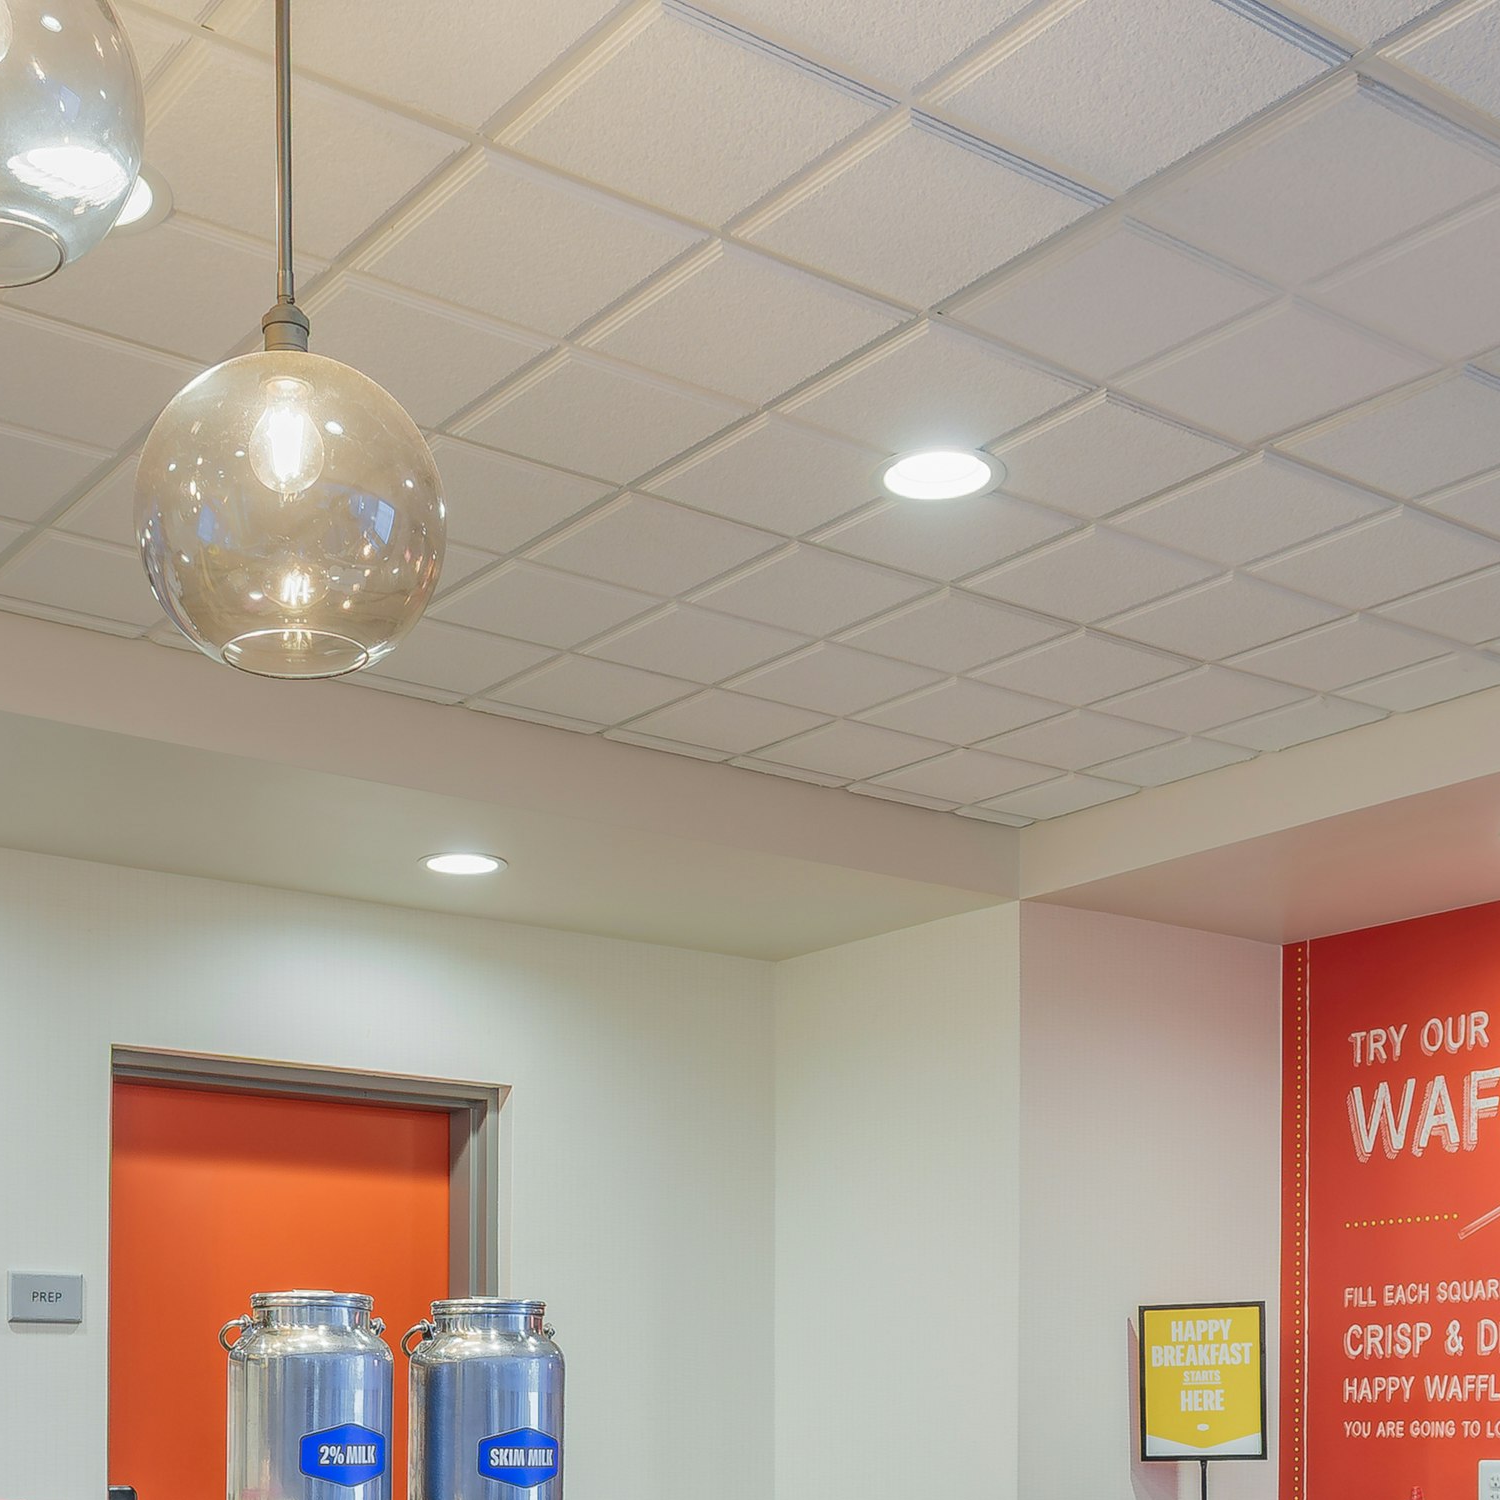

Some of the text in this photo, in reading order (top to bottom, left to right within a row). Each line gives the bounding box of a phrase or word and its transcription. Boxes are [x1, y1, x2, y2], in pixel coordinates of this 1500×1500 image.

[1349, 1024, 1407, 1067] TRY
[1420, 1011, 1490, 1056] OUR
[31, 1291, 62, 1303] PREP
[1344, 1286, 1377, 1308] FILL
[1383, 1283, 1430, 1306] EACH
[1171, 1318, 1233, 1342] HAPPY
[1343, 1322, 1432, 1360] CRISP
[1444, 1319, 1464, 1357] &
[1151, 1342, 1253, 1367] BREAKFAST
[1183, 1370, 1221, 1382] STARTS
[1180, 1389, 1225, 1412] HERE
[1343, 1375, 1415, 1403] HAPPY
[1344, 1420, 1371, 1438] YOU
[1376, 1420, 1404, 1438] ARE
[1410, 1420, 1456, 1438] GOING
[1461, 1420, 1481, 1438] TO
[319, 1445, 376, 1465] 2% MILK
[490, 1448, 554, 1467] SKIM MILK
